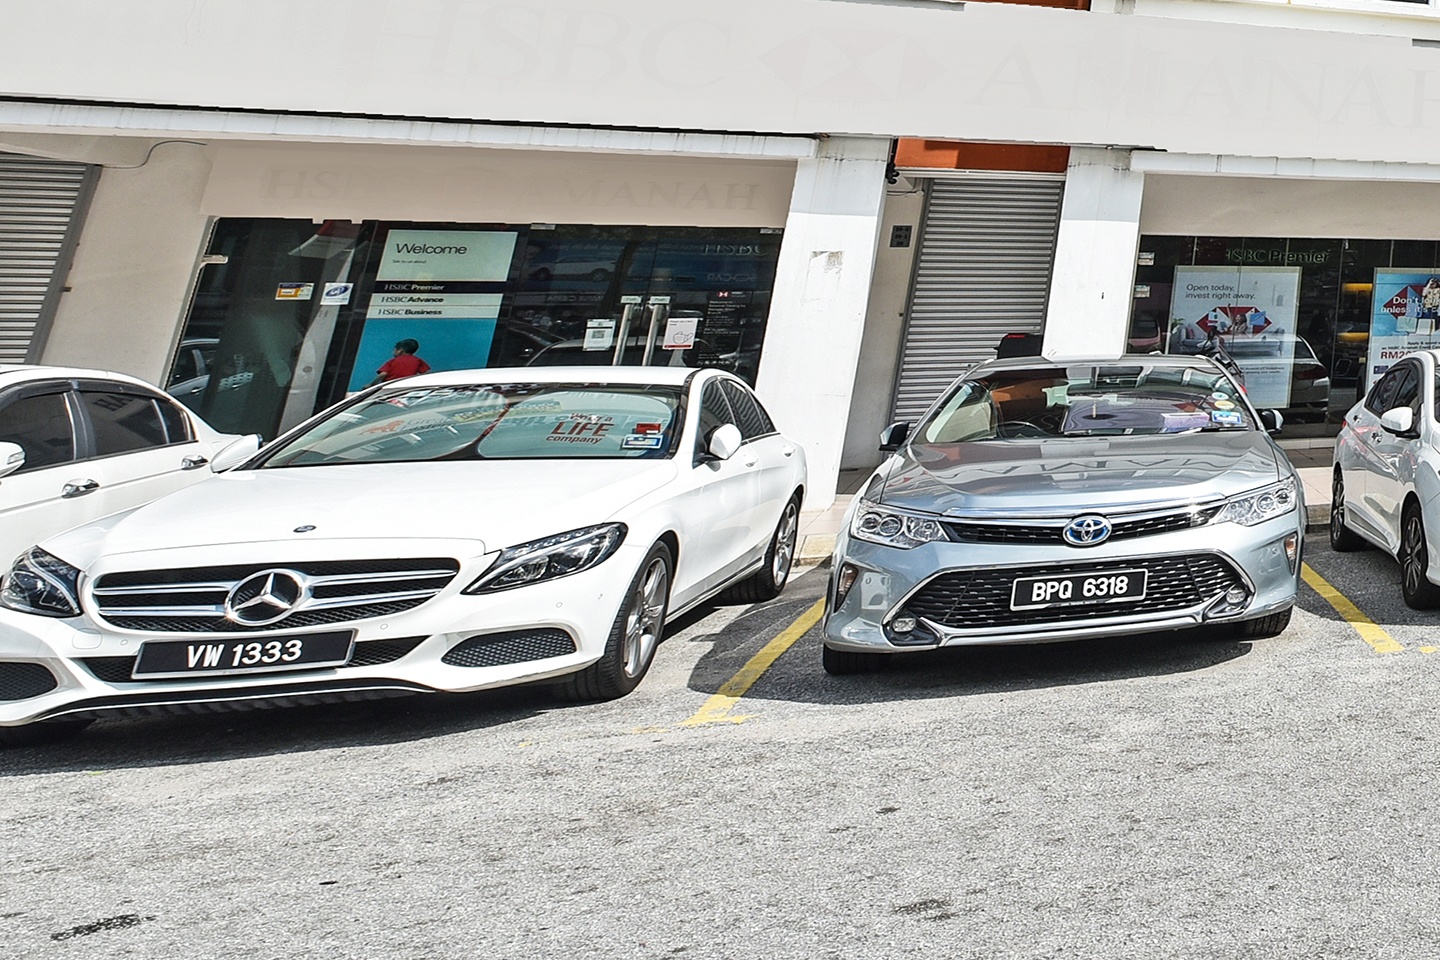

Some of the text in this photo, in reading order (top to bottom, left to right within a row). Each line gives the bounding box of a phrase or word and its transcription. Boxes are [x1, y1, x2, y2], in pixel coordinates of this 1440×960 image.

[396, 243, 468, 255] Welcome
[1269, 248, 1330, 264] Premier
[411, 283, 446, 291] Premier
[1186, 284, 1209, 292] Open
[1212, 292, 1231, 300] right
[1392, 296, 1420, 305] Don't
[1380, 306, 1412, 314] unless
[550, 422, 615, 436] LIFE
[545, 435, 603, 445] company
[1031, 575, 1129, 602] BPQ 6318
[187, 640, 303, 668] VW 1333
